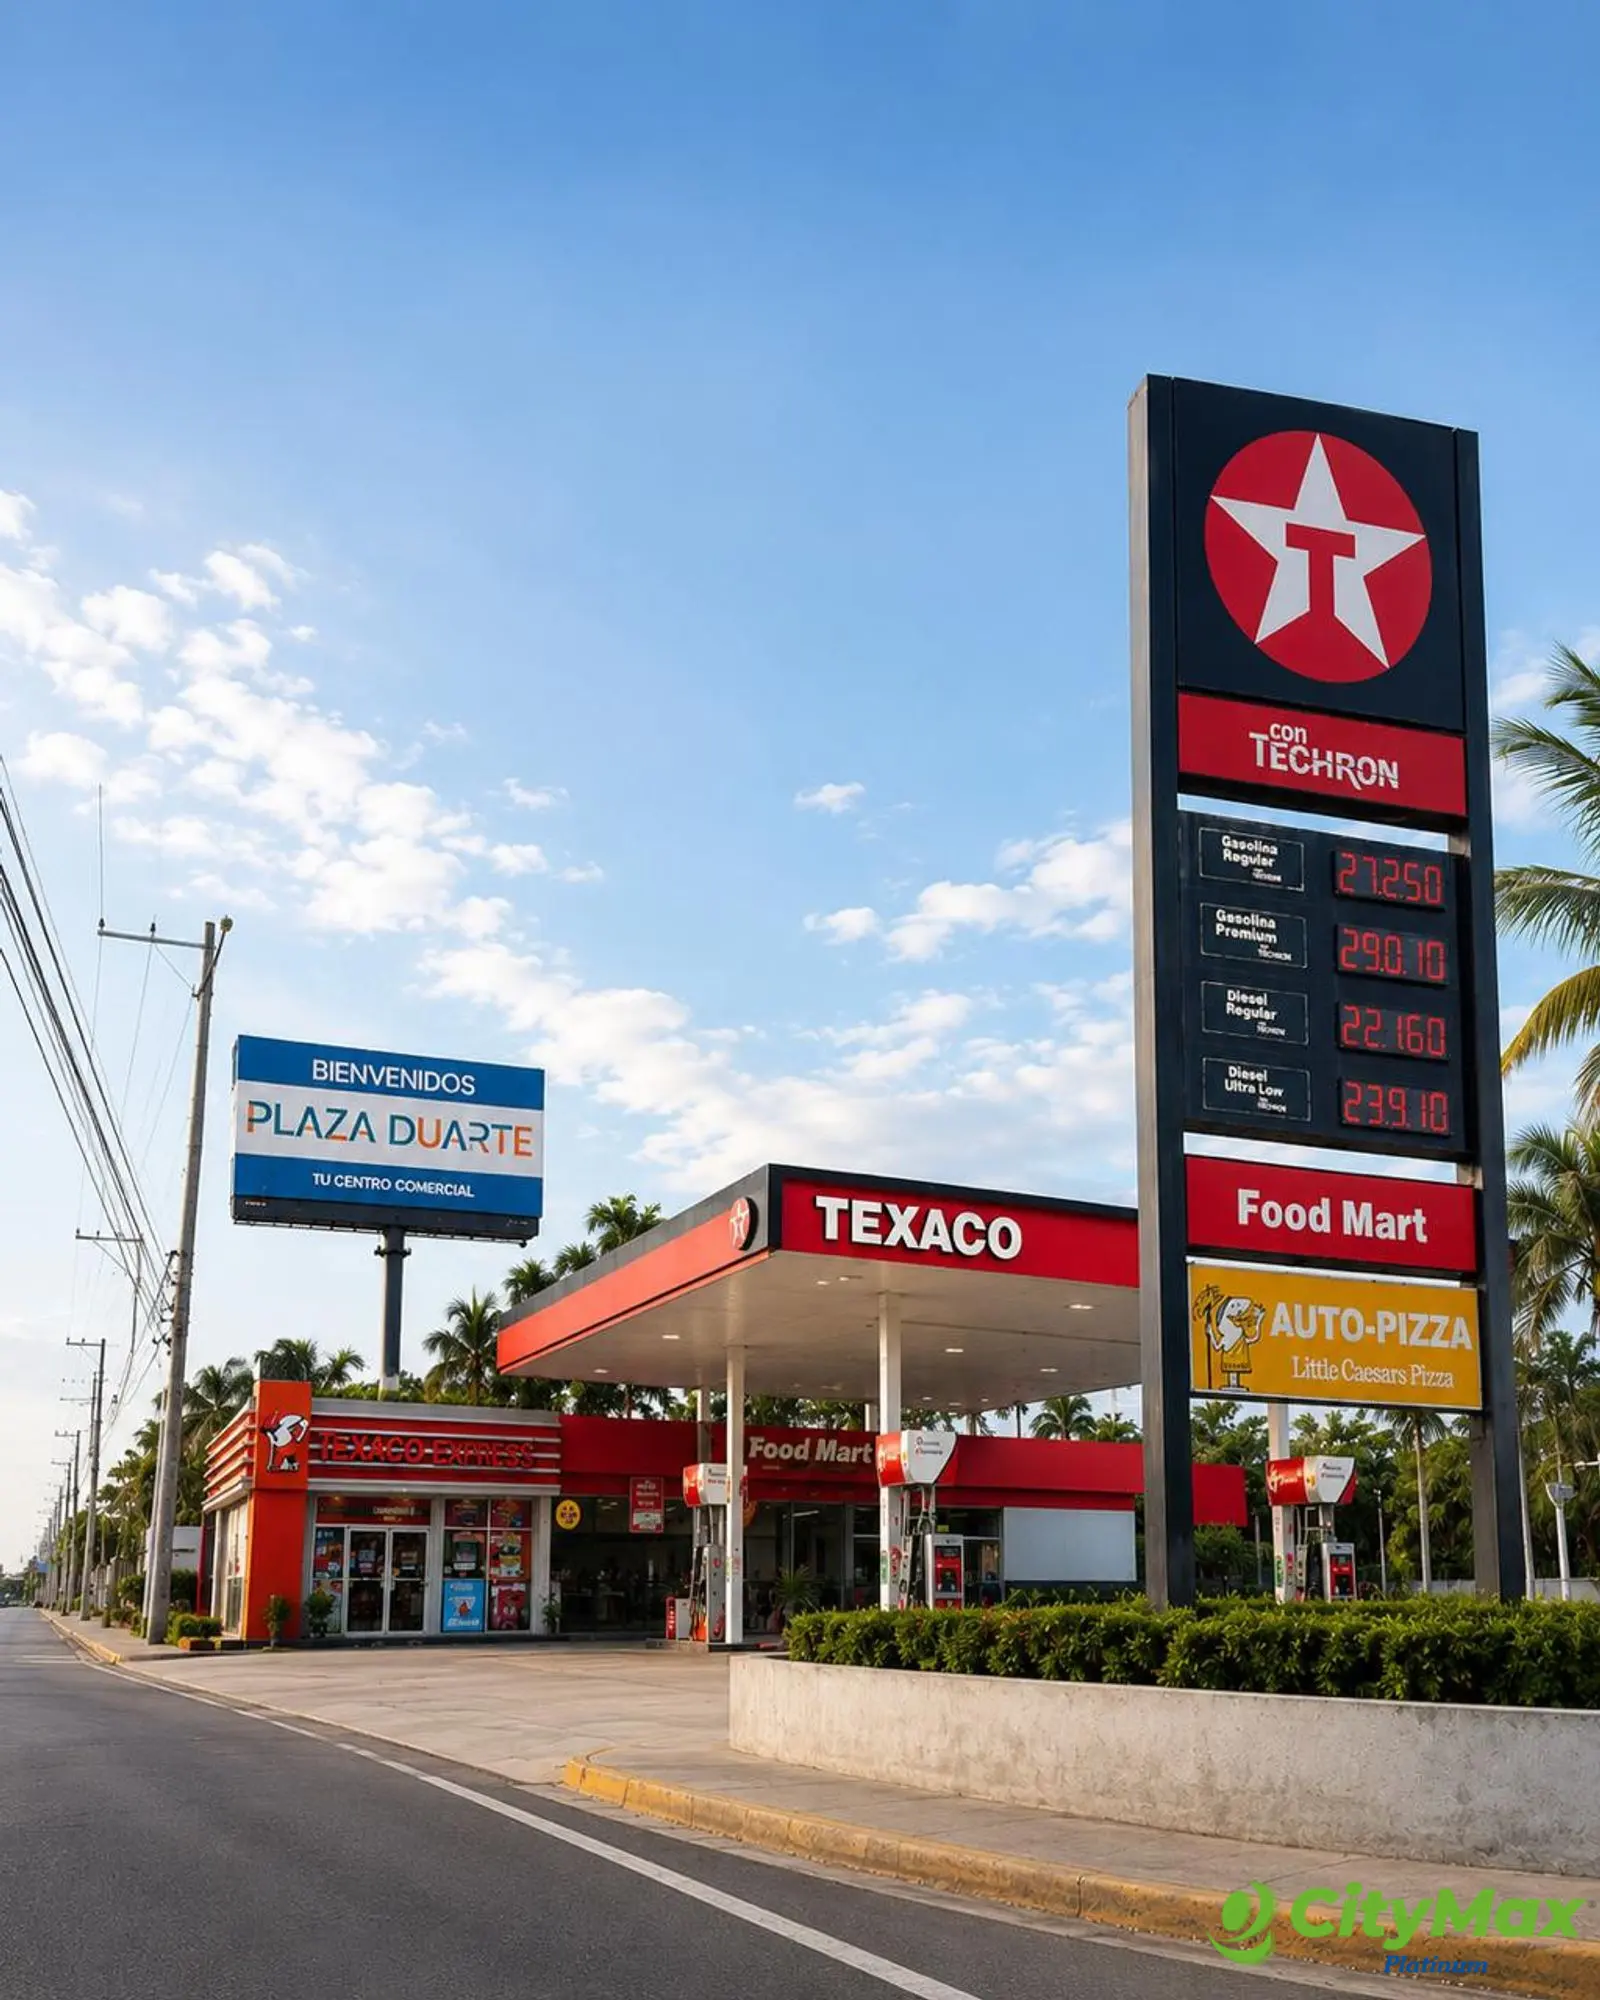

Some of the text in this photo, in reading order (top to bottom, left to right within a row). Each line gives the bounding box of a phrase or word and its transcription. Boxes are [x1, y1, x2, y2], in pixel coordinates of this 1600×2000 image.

[1269, 722, 1307, 745] con
[1249, 732, 1399, 790] TECHRON
[1221, 835, 1278, 855] Gasolina
[1223, 849, 1275, 867] Regular
[1215, 909, 1276, 929] Gasolina
[1215, 923, 1277, 944] Premium
[1227, 989, 1268, 1006] Diesel
[1226, 1002, 1278, 1021] Regular
[312, 1058, 476, 1096] BIENVENIDOS
[1228, 1065, 1268, 1082] Diesel
[1224, 1079, 1284, 1097] Ultra Low
[246, 1100, 533, 1157] PLAZA DUARTE
[312, 1173, 474, 1198] TU CENTRO COMERCIAL
[816, 1195, 1022, 1261] TEXACO
[1237, 1188, 1428, 1244] Food Mart
[1269, 1301, 1473, 1351] AUTO-PIZZA
[1292, 1355, 1455, 1389] Little Caesars Pizza
[319, 1431, 534, 1469] TEXACO EXPRESS
[748, 1435, 808, 1461] Food
[815, 1438, 873, 1464] Mart
